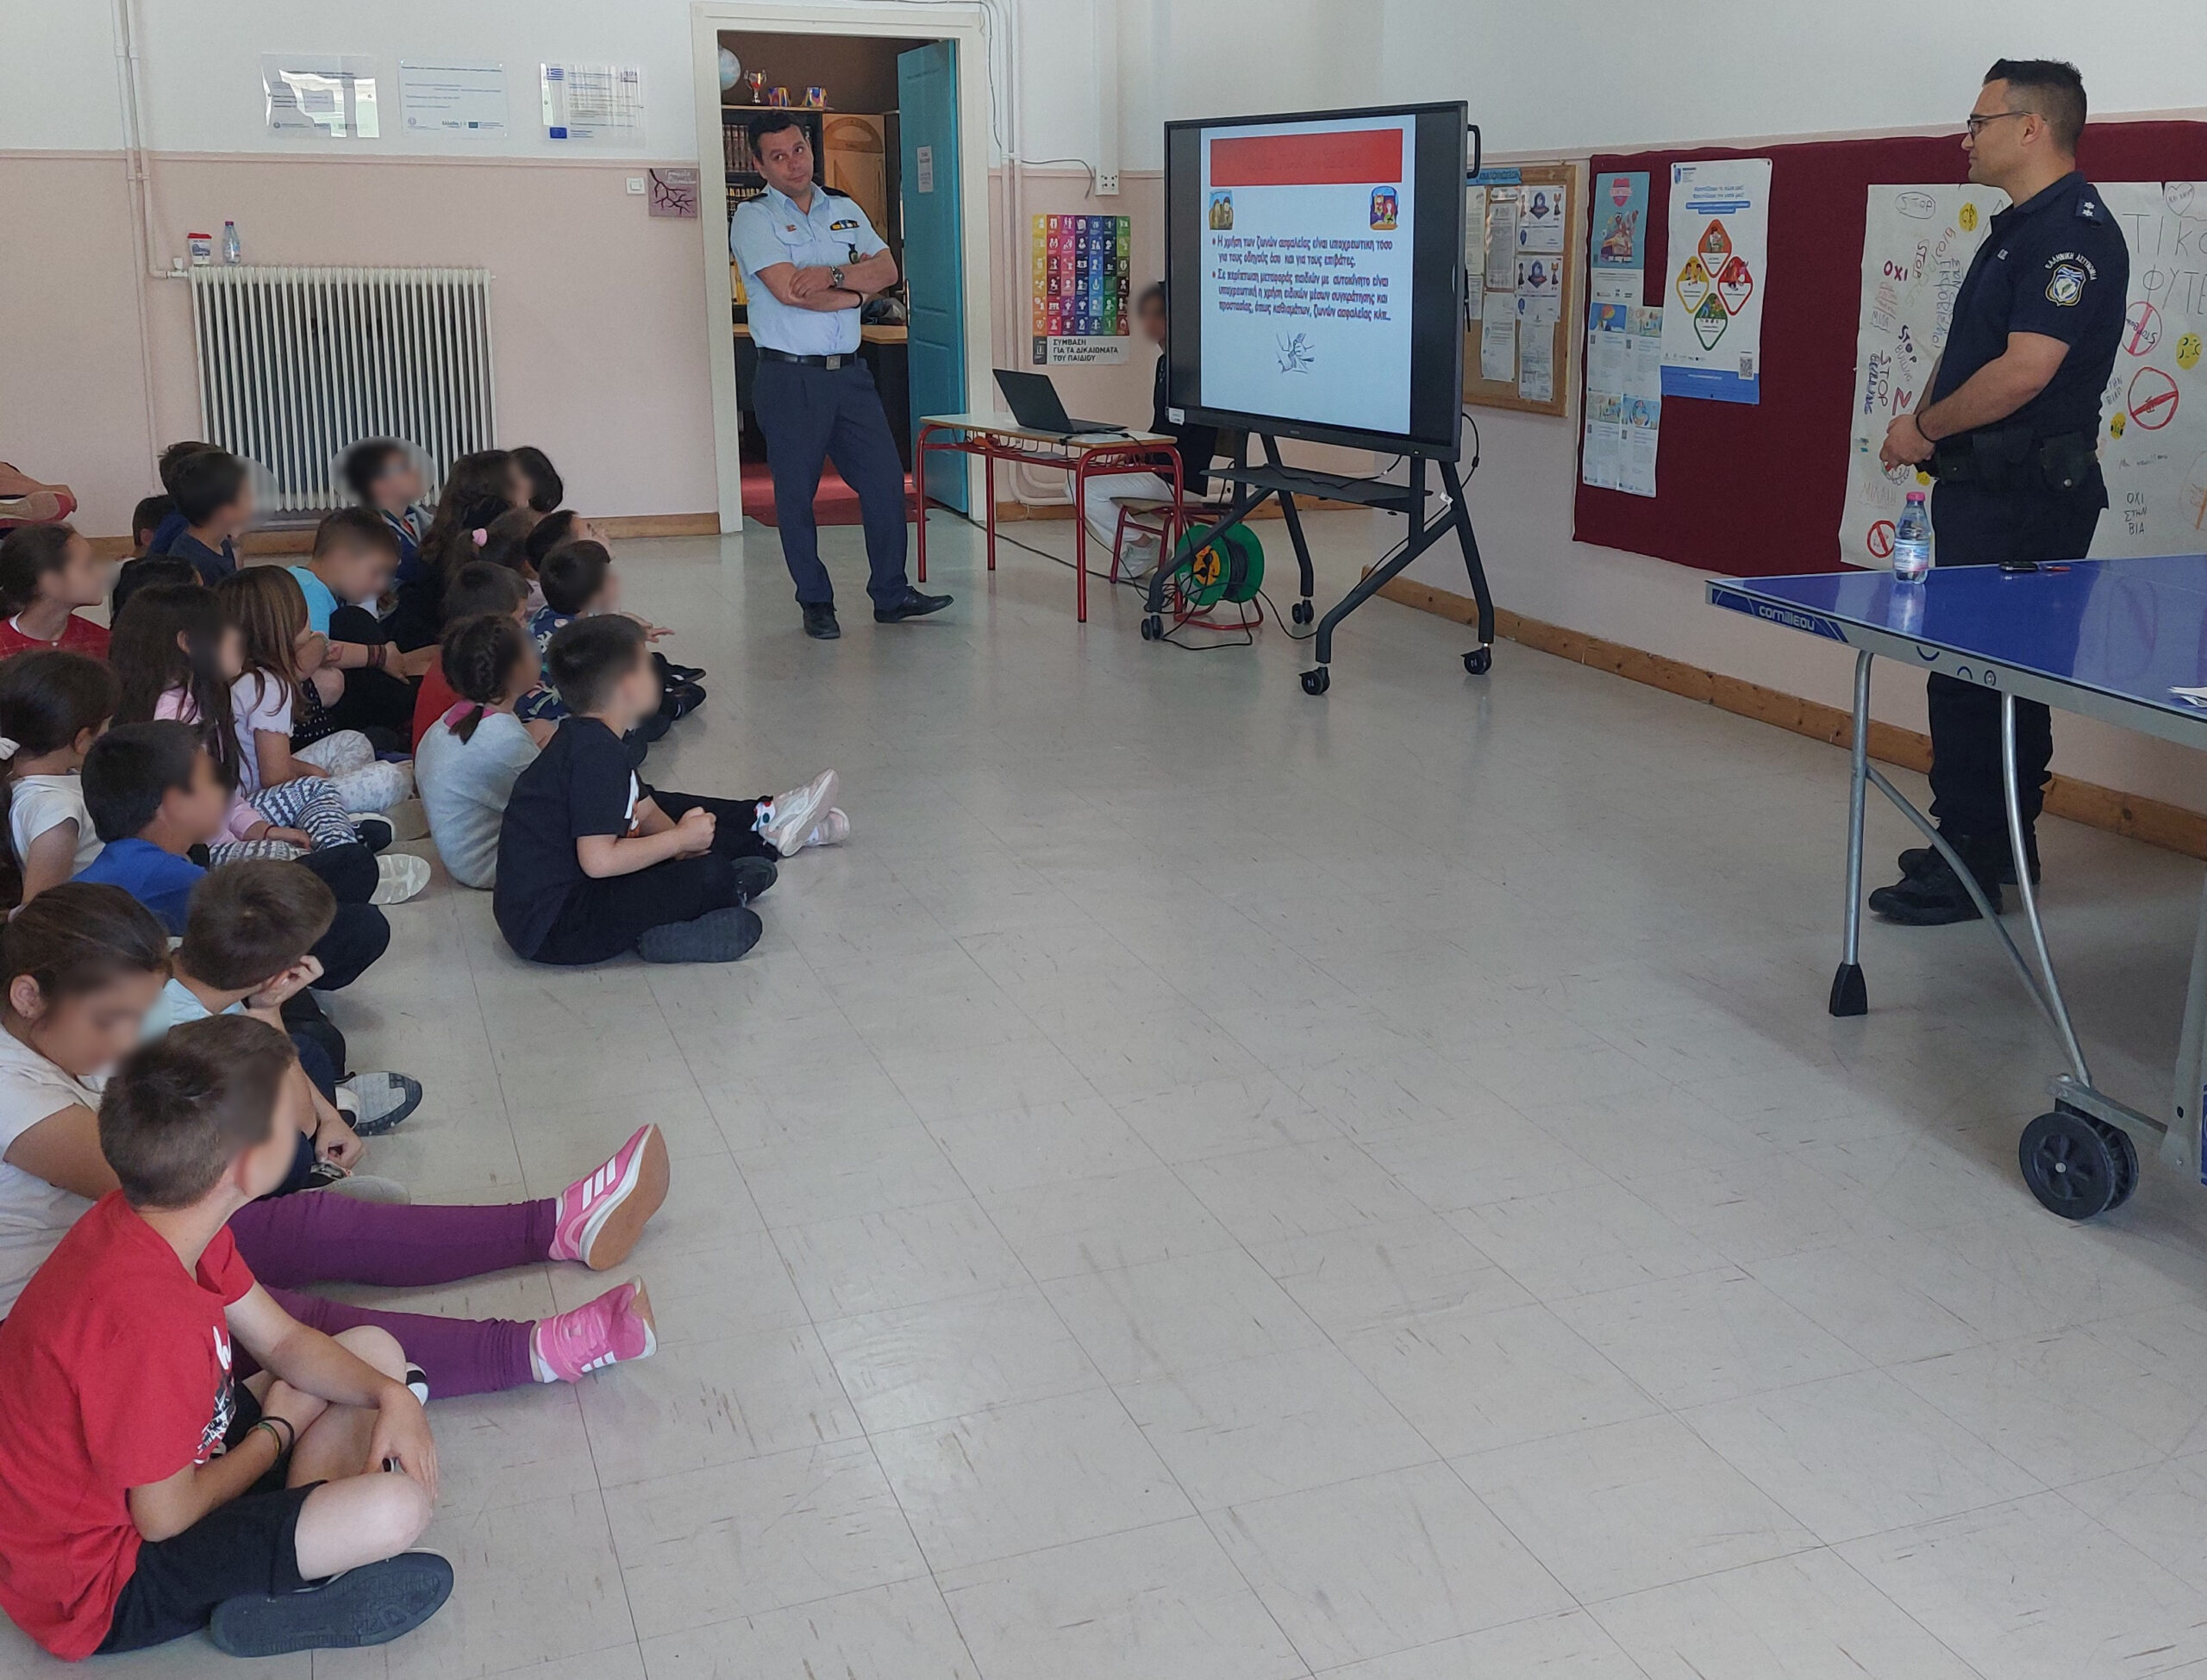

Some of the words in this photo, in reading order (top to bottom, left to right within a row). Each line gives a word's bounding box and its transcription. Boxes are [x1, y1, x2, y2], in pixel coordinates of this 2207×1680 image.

[1217, 234, 1223, 247] Η
[1224, 235, 1242, 249] χρήση
[1243, 238, 1255, 247] των
[1279, 236, 1310, 251] ασφαλείας
[1312, 236, 1328, 249] είναι
[1376, 239, 1393, 250] τόσο
[1218, 253, 1228, 263] για
[1229, 253, 1242, 265] τους
[1244, 251, 1268, 265] οδηγούς
[1285, 254, 1294, 264] και
[1296, 255, 1306, 266] για
[1307, 255, 1322, 267] τους
[2045, 252, 2074, 269] ΕΛΛΗΝΙΚΗ
[2075, 253, 2098, 281] ΑΣΤΥΝΟΜΙΑ
[1217, 268, 1226, 280] Σε
[1260, 271, 1293, 285] μεταφοράς
[1295, 272, 1320, 284] παιδιών
[1322, 275, 1329, 287] με
[1333, 273, 1371, 287] αυτοκίνητο
[1372, 274, 1389, 287] είναι
[1219, 285, 1257, 298] υποχρεωτική
[1264, 286, 1283, 299] χρήση
[1285, 287, 1309, 299] ειδικών
[1310, 288, 1330, 302] μέσων
[1332, 290, 1375, 305] συγκράτησης
[1377, 294, 1388, 303] και
[1337, 307, 1372, 322] ασφαλείας
[1067, 354, 1096, 363] ΠΑΙΔΙΟΥ
